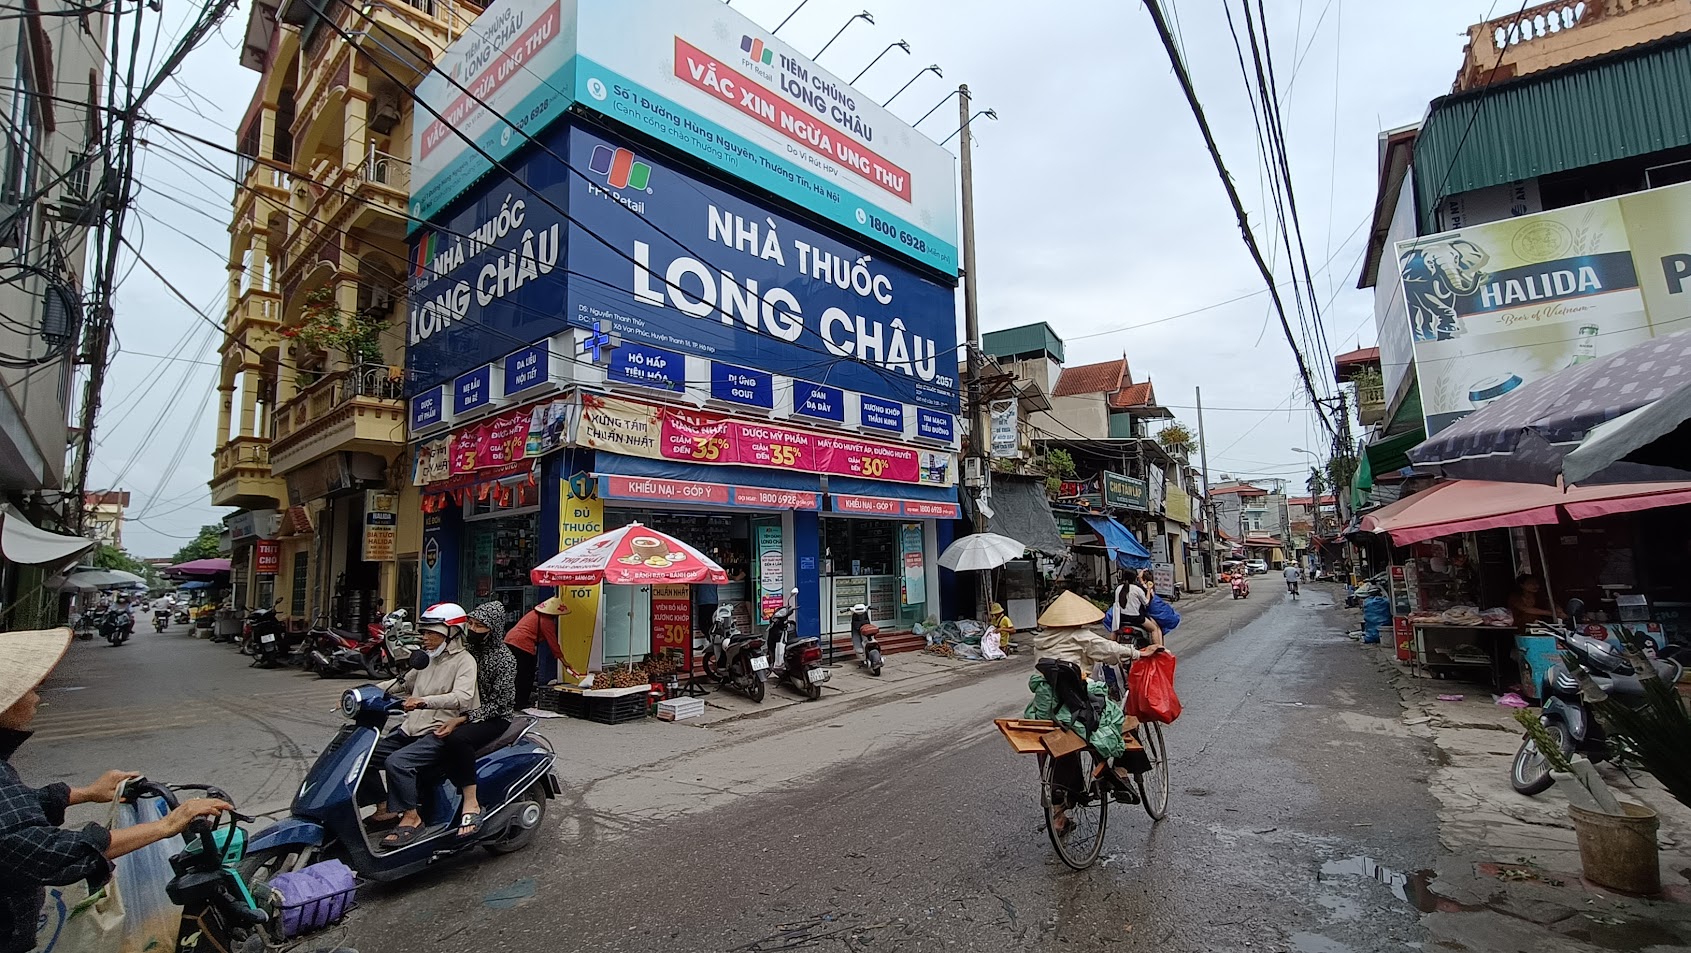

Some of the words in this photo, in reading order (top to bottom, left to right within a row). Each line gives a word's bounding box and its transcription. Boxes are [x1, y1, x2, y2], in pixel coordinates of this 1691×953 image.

[464, 50, 491, 82] LONG
[493, 10, 525, 51] CHÂU
[464, 40, 481, 62] TIÊM
[498, 47, 523, 82] UNG
[525, 14, 553, 54] THƯ
[741, 58, 754, 71] FPT
[754, 65, 773, 82] Retail
[779, 53, 808, 83] TIÊM
[812, 75, 856, 112] CHỦNG
[613, 101, 642, 122] (Cạnh
[780, 72, 827, 114] LONG
[830, 105, 873, 142] CHÂU
[686, 57, 735, 99] VẮC
[739, 86, 775, 122] XIN
[780, 110, 833, 155] NGỪA
[836, 142, 871, 175] UNG
[873, 163, 904, 192] THƯ
[613, 84, 631, 101] Số
[632, 93, 638, 104] 1
[640, 97, 682, 127] Đường
[683, 117, 714, 143] Hùng
[759, 155, 794, 182] Thường
[795, 174, 812, 191] Tín,
[813, 183, 826, 197] Hà
[826, 188, 841, 204] Nội
[787, 144, 798, 156] Do
[808, 154, 822, 171] Rút
[823, 161, 839, 176] HPV
[588, 182, 611, 202] FPT
[612, 190, 646, 216] Retail
[1449, 201, 1460, 215] AN
[433, 235, 465, 282] NHÀ
[468, 192, 526, 260] THUỐC
[868, 213, 897, 240] 1800
[899, 230, 927, 254] 6928
[707, 204, 787, 267] NHÀ
[793, 239, 894, 306] THUỐC
[410, 279, 472, 347] LONG
[476, 222, 560, 307] CHÂU
[1480, 265, 1603, 309] HALIDA
[578, 304, 589, 314] DS:
[589, 306, 613, 320] Nguyễn
[613, 312, 632, 324] Thanh
[633, 240, 805, 343] LONG
[819, 305, 937, 381] CHÂU
[1501, 313, 1530, 326] Beer
[1531, 311, 1541, 322] of
[1542, 302, 1590, 319] Vietnam
[516, 360, 526, 371] DA
[628, 352, 645, 365] HÔ
[645, 355, 668, 369] HẤP
[515, 373, 527, 386] NỘI
[526, 368, 539, 383] TIẾT
[728, 373, 738, 387] DỊ
[739, 374, 757, 388] ỨNG
[935, 374, 955, 389] 2057
[463, 382, 472, 394] MẸ
[731, 387, 755, 400] GOUT
[811, 389, 827, 401] GAN
[420, 397, 434, 410] DƯỢC
[464, 395, 473, 406] EM
[806, 401, 817, 412] DẠ
[817, 401, 832, 413] DÀY
[863, 403, 885, 415] XƯƠNG
[884, 406, 901, 418] KHỚP
[867, 413, 884, 424] THẦN
[884, 417, 898, 427] KINH
[923, 414, 932, 423] TIM
[932, 416, 947, 427] MẠCH
[669, 435, 692, 445] GIẢM
[742, 427, 769, 439] DƯỢC
[769, 431, 783, 442] MỸ
[784, 433, 808, 445] PHẨM
[673, 445, 691, 454] ĐẾN
[752, 443, 769, 452] GIẢM
[769, 444, 802, 466] 35%
[756, 451, 770, 460] ĐẾN
[817, 440, 832, 449] MÁY
[832, 442, 844, 451] ĐO
[843, 443, 864, 453] HUYẾT
[863, 445, 874, 456] ÁP,
[873, 447, 895, 458] ĐƯỜNG
[894, 449, 912, 460] HUYẾT
[861, 456, 889, 477] 30%
[576, 478, 585, 497] 1
[628, 479, 657, 495] KHIẾU
[658, 483, 675, 498] NẠI
[683, 486, 703, 499] GÓP
[705, 485, 712, 498] Ý
[759, 492, 777, 504] 1800
[777, 494, 796, 506] 6928
[845, 498, 862, 509] KHIẾU
[862, 500, 873, 512] NẠI
[876, 502, 890, 511] GÓP
[889, 502, 894, 511] Ý
[574, 506, 590, 519] ĐỦ
[563, 521, 601, 533] THUỐC
[571, 589, 592, 598] TỐT
